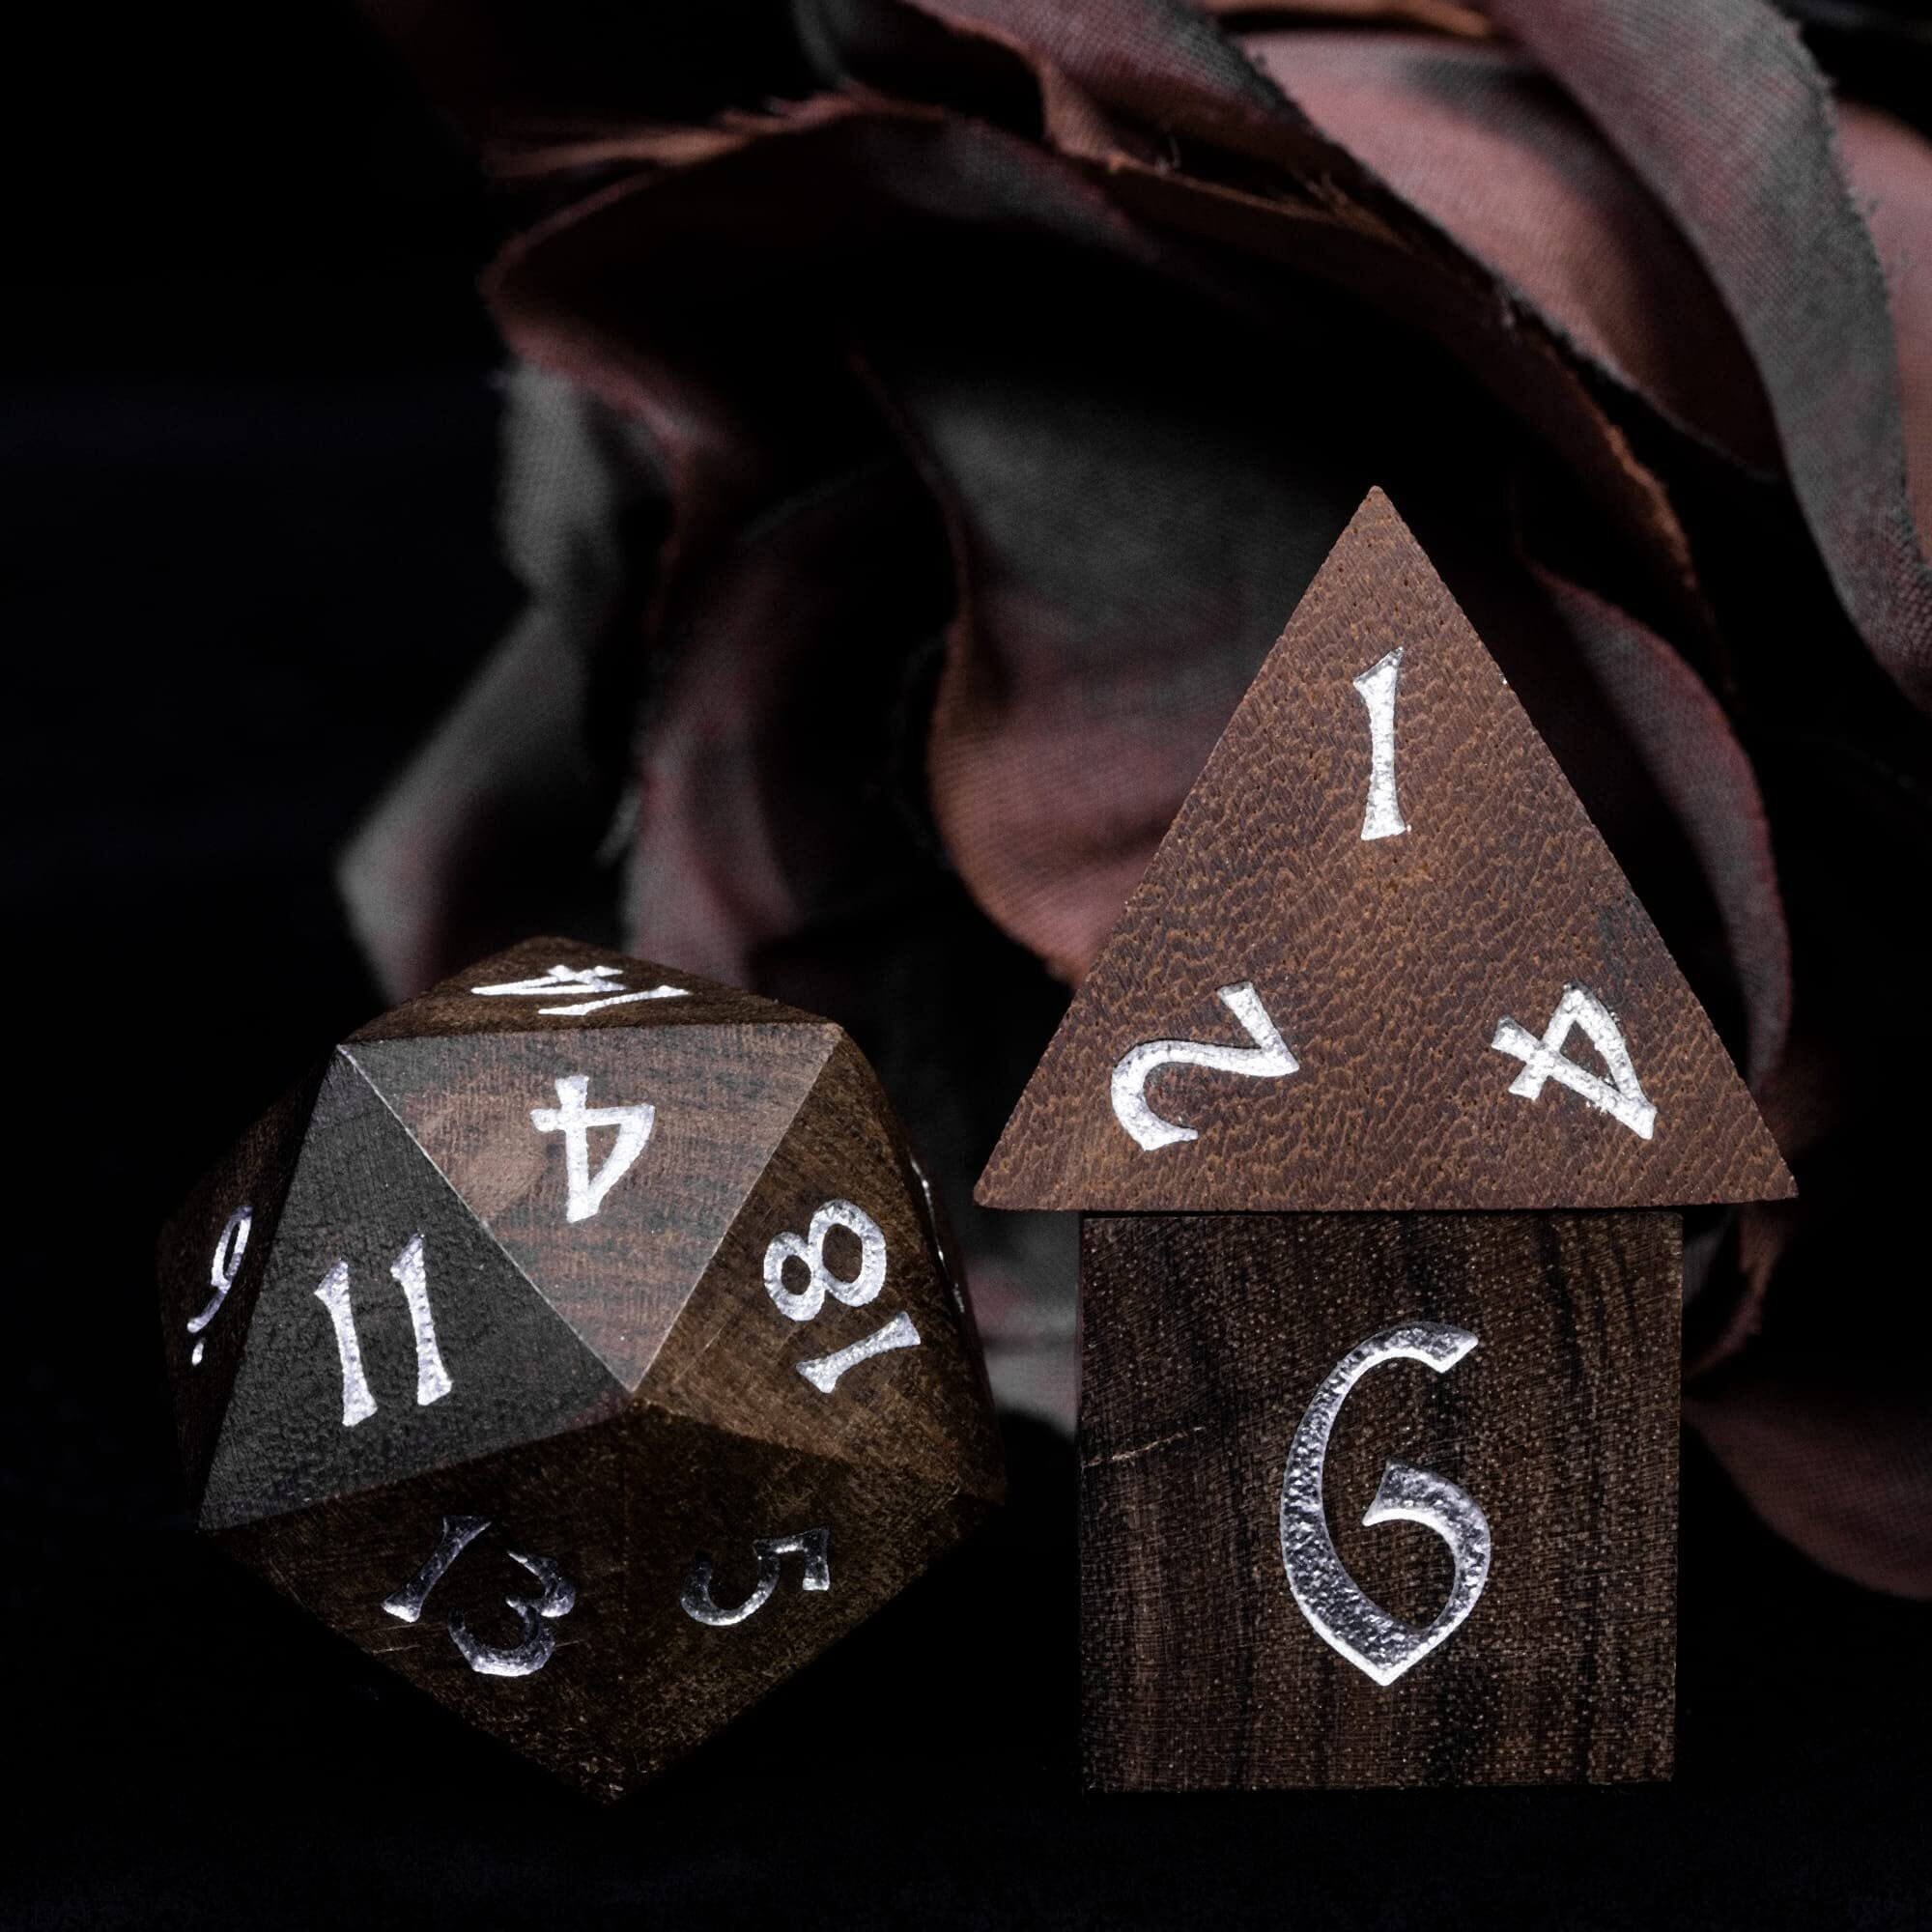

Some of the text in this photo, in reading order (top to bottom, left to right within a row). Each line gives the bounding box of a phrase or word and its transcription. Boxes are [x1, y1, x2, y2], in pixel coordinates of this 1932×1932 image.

[1352, 648, 1410, 841] 1
[1110, 982, 1300, 1152] 2
[1491, 985, 1657, 1141] 4
[529, 1074, 656, 1224] 4
[313, 1234, 453, 1428] 11
[762, 1199, 922, 1394] 18
[681, 1527, 831, 1627] 5
[1279, 1321, 1493, 1688] 6
[384, 1516, 576, 1678] 13
